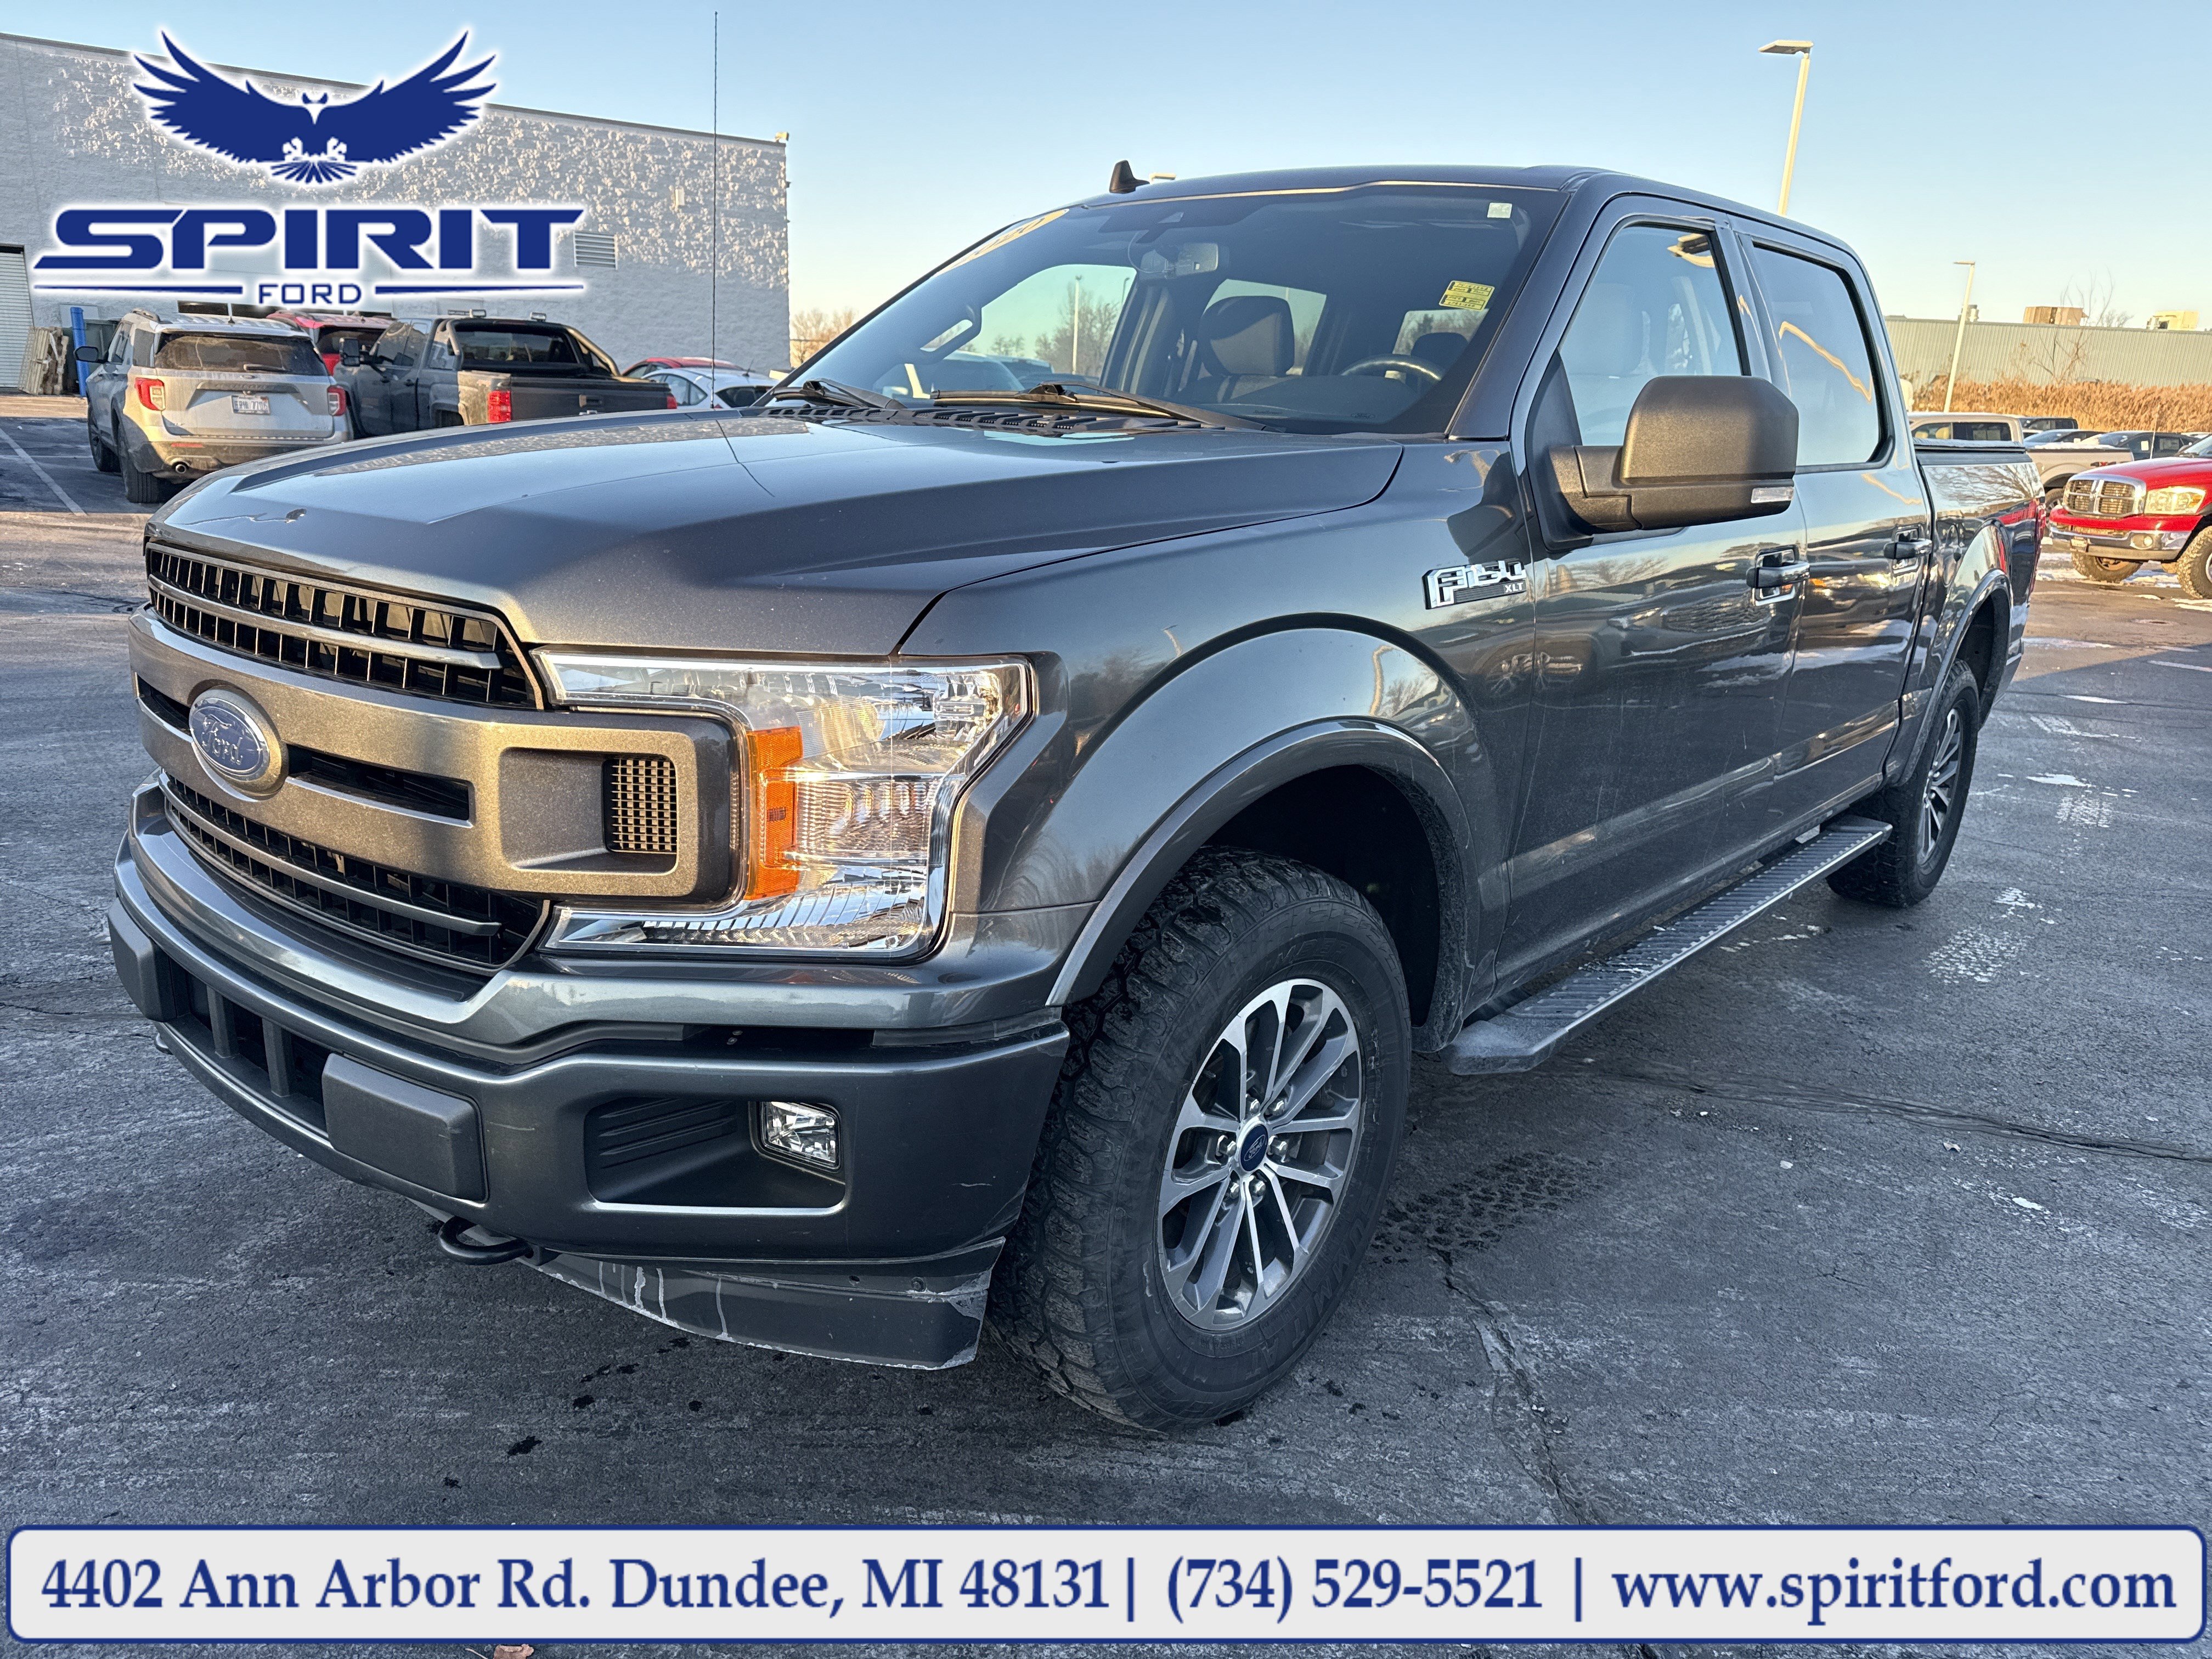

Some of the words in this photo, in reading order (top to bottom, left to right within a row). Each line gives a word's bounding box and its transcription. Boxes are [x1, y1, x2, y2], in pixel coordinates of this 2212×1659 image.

[1505, 582, 1523, 594] XLT
[201, 714, 243, 765] Ford
[1248, 1138, 1263, 1159] Ford
